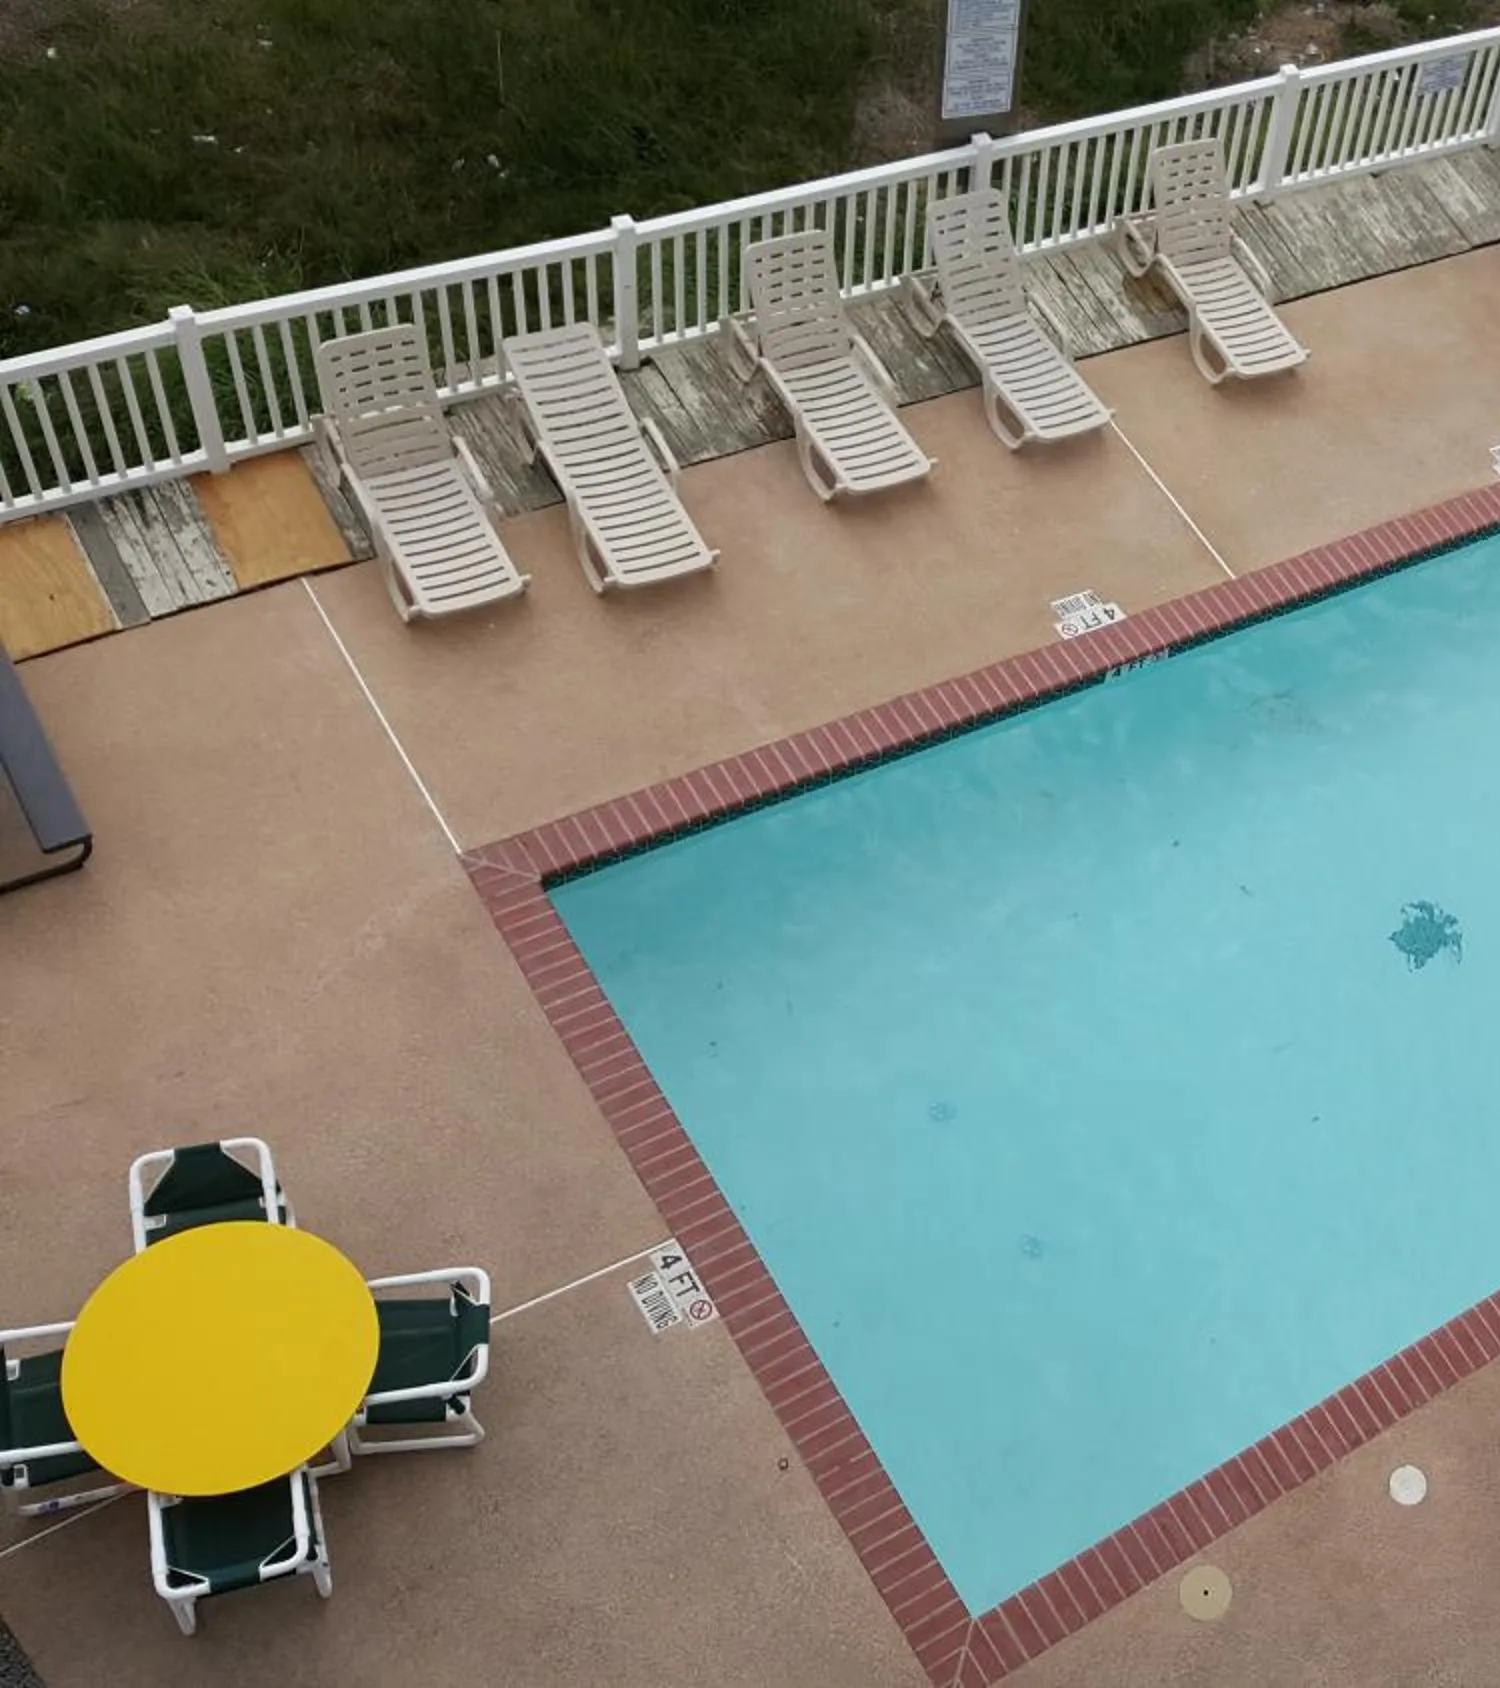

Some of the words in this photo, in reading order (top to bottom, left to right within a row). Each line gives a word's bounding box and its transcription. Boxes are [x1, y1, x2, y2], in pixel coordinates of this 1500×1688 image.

[1081, 611, 1102, 628] FT
[1103, 607, 1115, 620] 4
[660, 1255, 682, 1269] 4
[634, 1273, 659, 1295] NO
[668, 1271, 700, 1297] FT
[641, 1291, 679, 1329] DIVING
